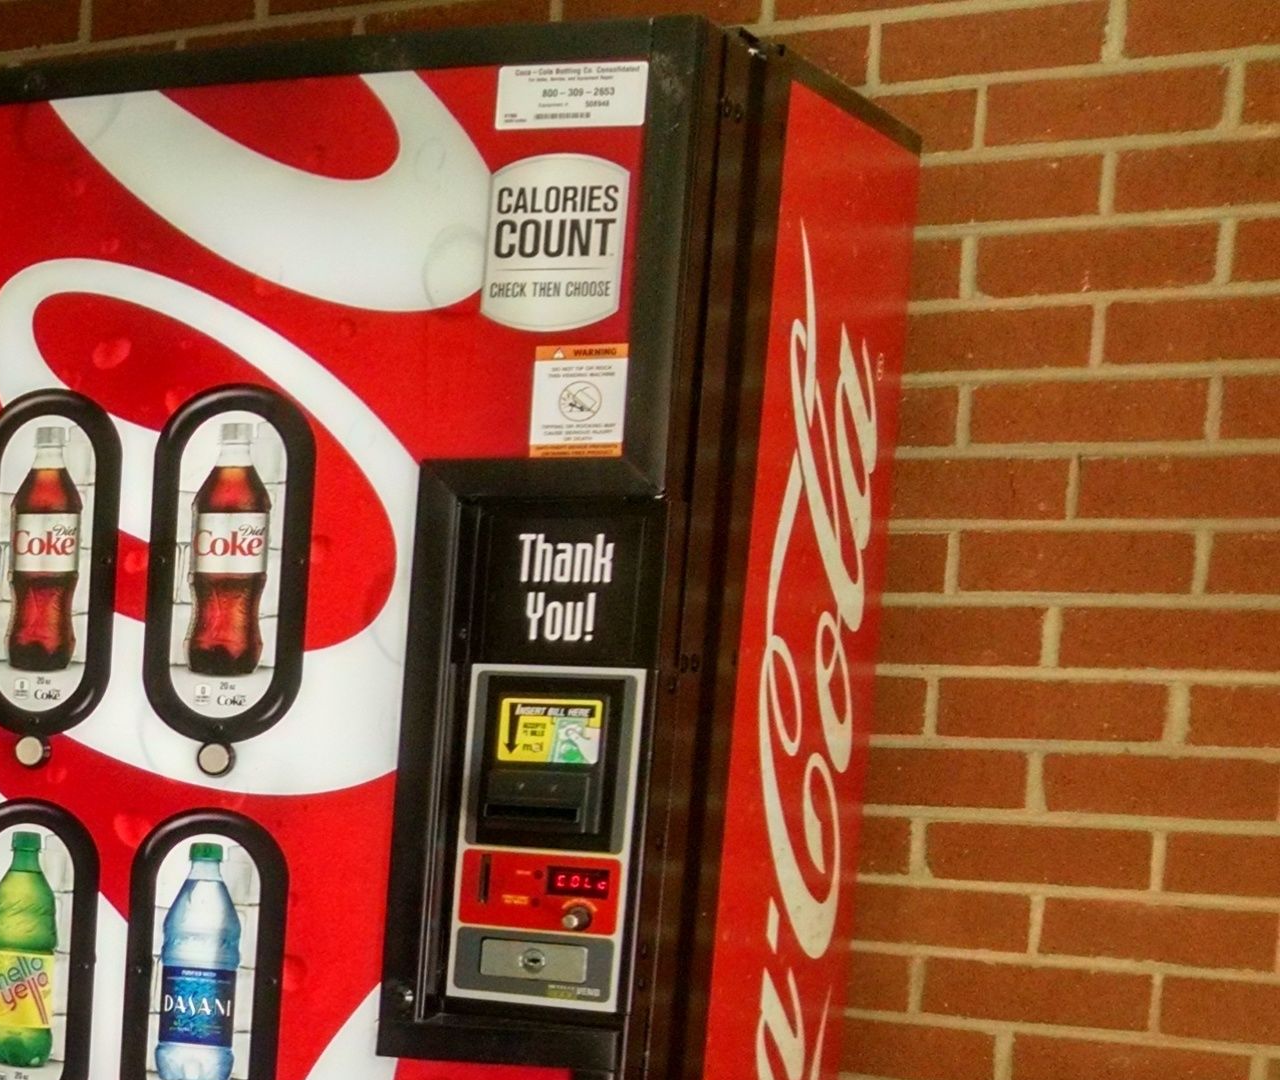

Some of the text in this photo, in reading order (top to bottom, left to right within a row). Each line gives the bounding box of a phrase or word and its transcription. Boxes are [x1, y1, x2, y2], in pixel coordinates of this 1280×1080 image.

[497, 185, 619, 214] CALORIES
[494, 218, 617, 259] COUNT
[489, 280, 611, 298] CHECK THEN CHOOSE
[574, 348, 616, 356] WARNING
[52, 524, 76, 536] Diet
[238, 524, 266, 536] Diet
[13, 530, 75, 555] Coke
[193, 529, 263, 556] Coke
[519, 533, 615, 583] Thank
[526, 592, 596, 642] You!
[34, 689, 61, 700] Coke
[220, 682, 228, 690] 20
[217, 696, 246, 706] Coke
[515, 704, 592, 717] INSERT BILL HERE
[1, 972, 48, 1024] yello
[164, 994, 231, 1016] DASANI
